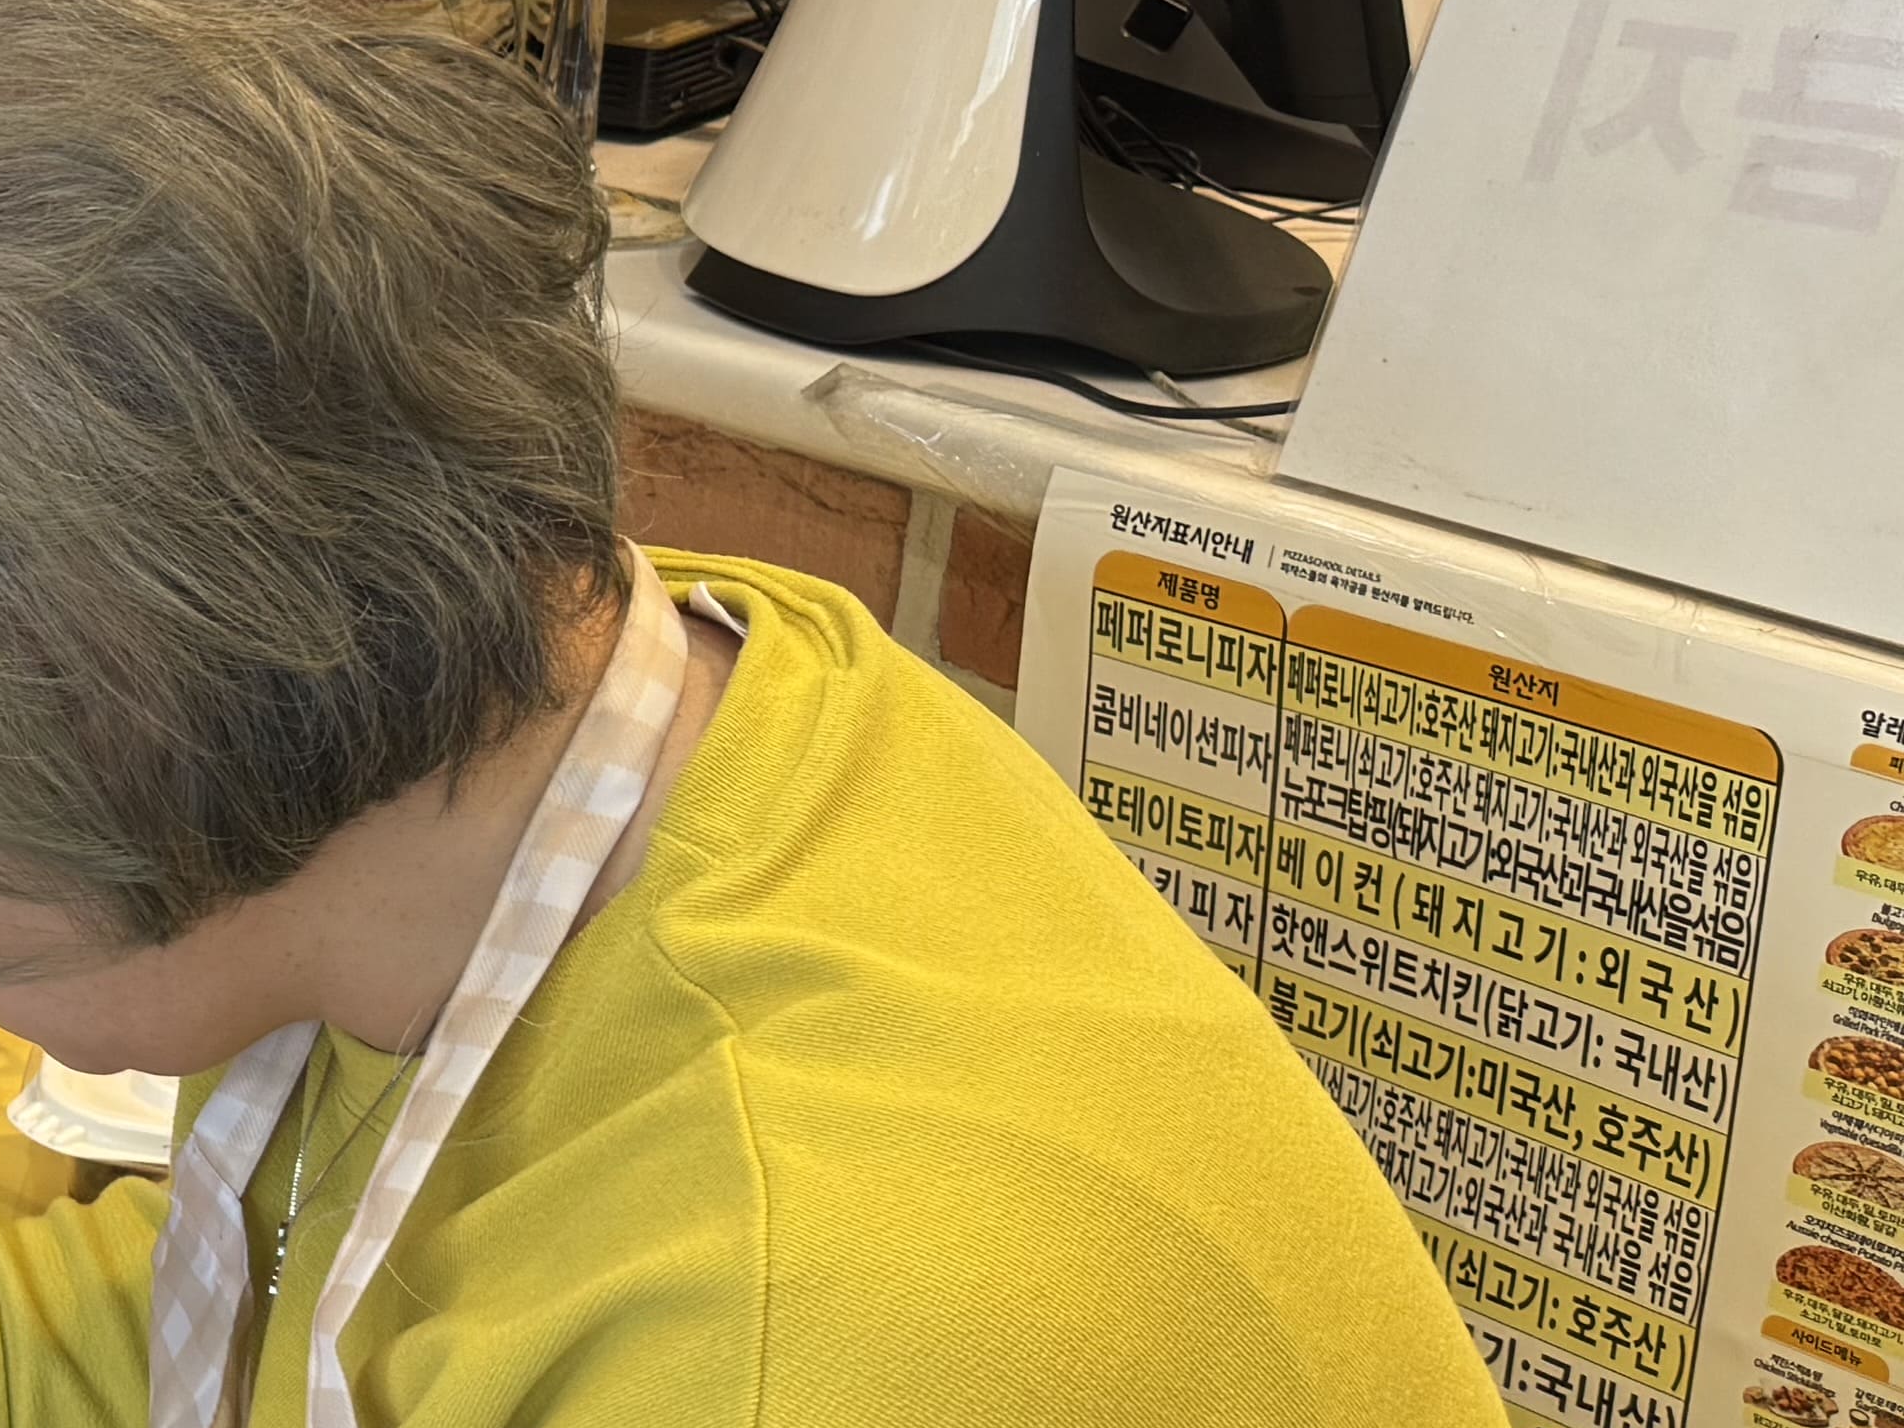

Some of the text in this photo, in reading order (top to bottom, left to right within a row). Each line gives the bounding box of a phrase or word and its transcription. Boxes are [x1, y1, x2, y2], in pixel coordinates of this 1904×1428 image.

[1110, 504, 1255, 565] 원산지표시안내
[1158, 572, 1220, 610] 제품명
[1096, 601, 1277, 696] 페퍼로니피자
[1489, 664, 1559, 707] 원산지
[1093, 683, 1272, 784] 콤비네이션피자
[1089, 777, 1265, 875] 포테이토피자
[1639, 752, 1717, 829] 외국산을
[1615, 1028, 1727, 1125] 국내산)
[1593, 1104, 1710, 1199] 호주산)
[1792, 1327, 1863, 1368] 사이드메뉴
